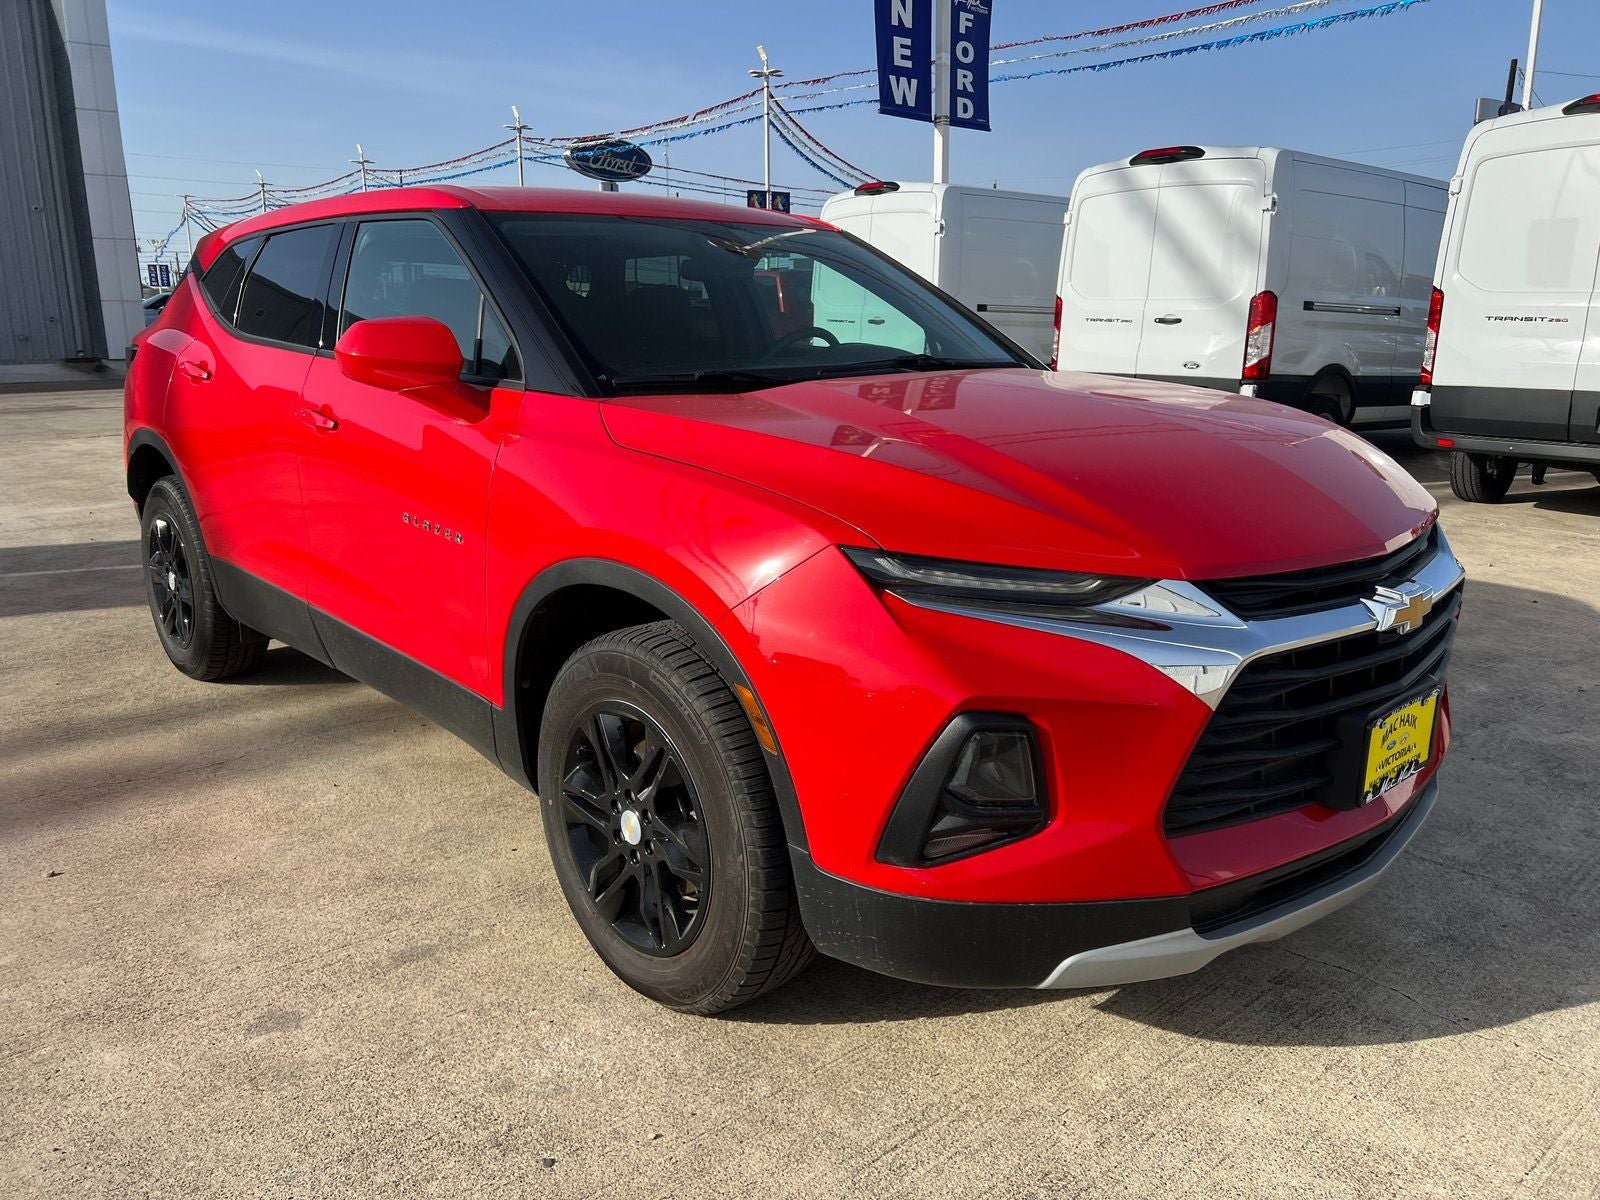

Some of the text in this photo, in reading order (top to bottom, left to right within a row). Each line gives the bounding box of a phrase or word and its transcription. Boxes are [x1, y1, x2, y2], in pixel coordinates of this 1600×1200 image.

[889, 0, 918, 107] NEW
[956, 12, 975, 119] FORD
[589, 146, 637, 173] Ford
[402, 512, 464, 544] BLAZER
[1381, 717, 1399, 746] MAC
[1399, 713, 1418, 730] HAIK
[1381, 745, 1411, 769] VICTORIA
